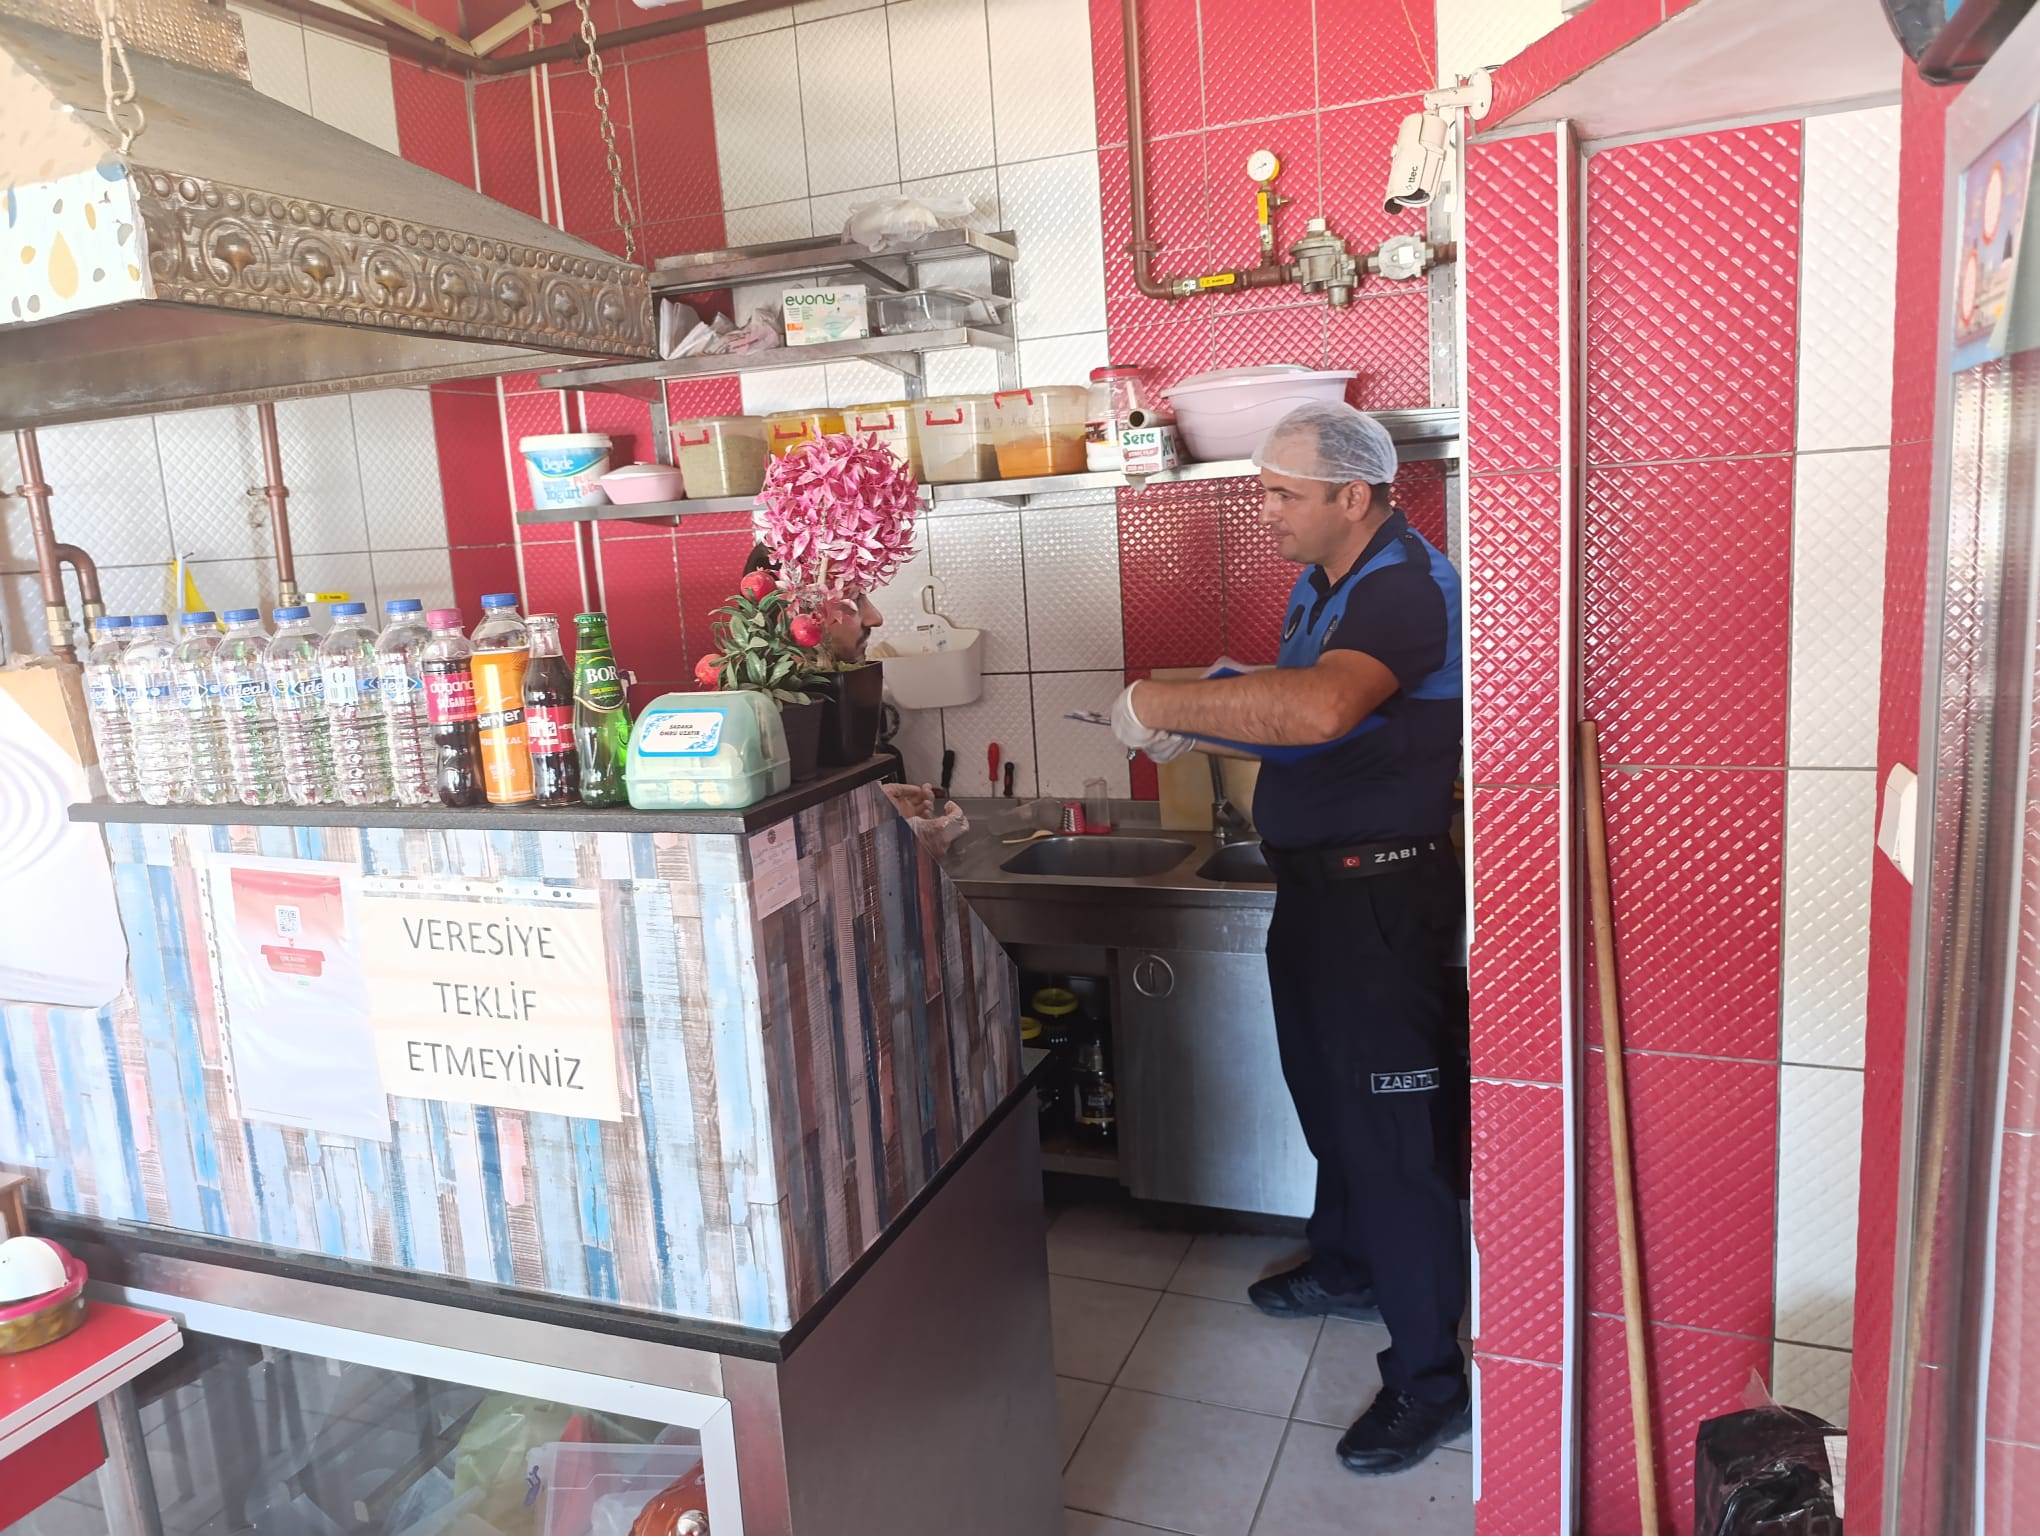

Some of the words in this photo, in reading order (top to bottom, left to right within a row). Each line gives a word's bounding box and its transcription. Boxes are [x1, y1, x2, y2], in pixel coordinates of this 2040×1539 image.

[785, 292, 835, 306] evony
[1122, 431, 1155, 446] Sera
[584, 666, 618, 684] BOR
[227, 683, 267, 695] ideal
[300, 682, 323, 695] ide
[402, 917, 556, 959] VERESİYE
[432, 981, 537, 1021] TEKLİF
[407, 1041, 584, 1090] ETMEYİNİZ
